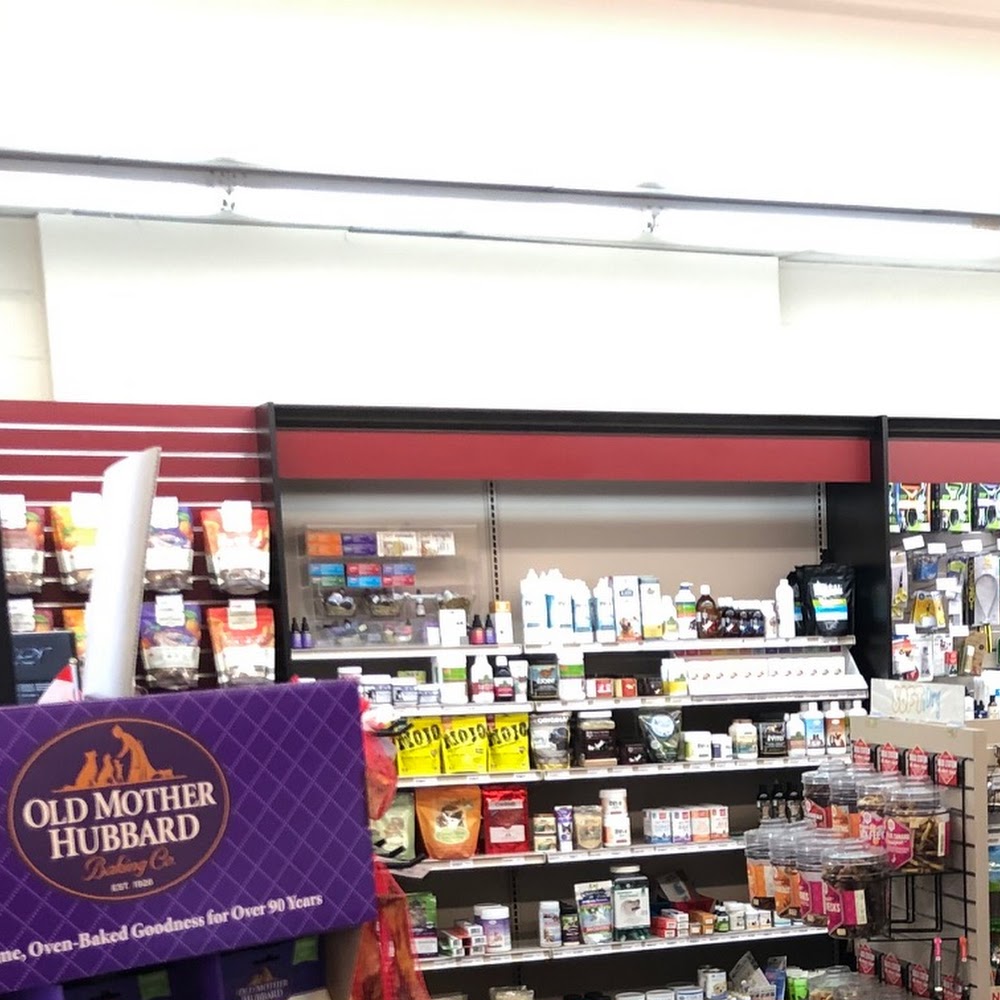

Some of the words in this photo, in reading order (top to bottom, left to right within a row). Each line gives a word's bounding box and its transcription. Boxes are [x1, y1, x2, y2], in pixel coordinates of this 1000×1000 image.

[22, 794, 89, 830] OLD
[93, 781, 217, 820] MOTHER
[48, 813, 201, 860] HUBBARD
[81, 854, 148, 882] Baking
[28, 925, 129, 957] Oven-Baked
[131, 916, 205, 939] Goodness
[206, 908, 230, 926] for
[231, 904, 266, 922] Over
[268, 898, 286, 914] 90
[286, 891, 324, 912] Years
